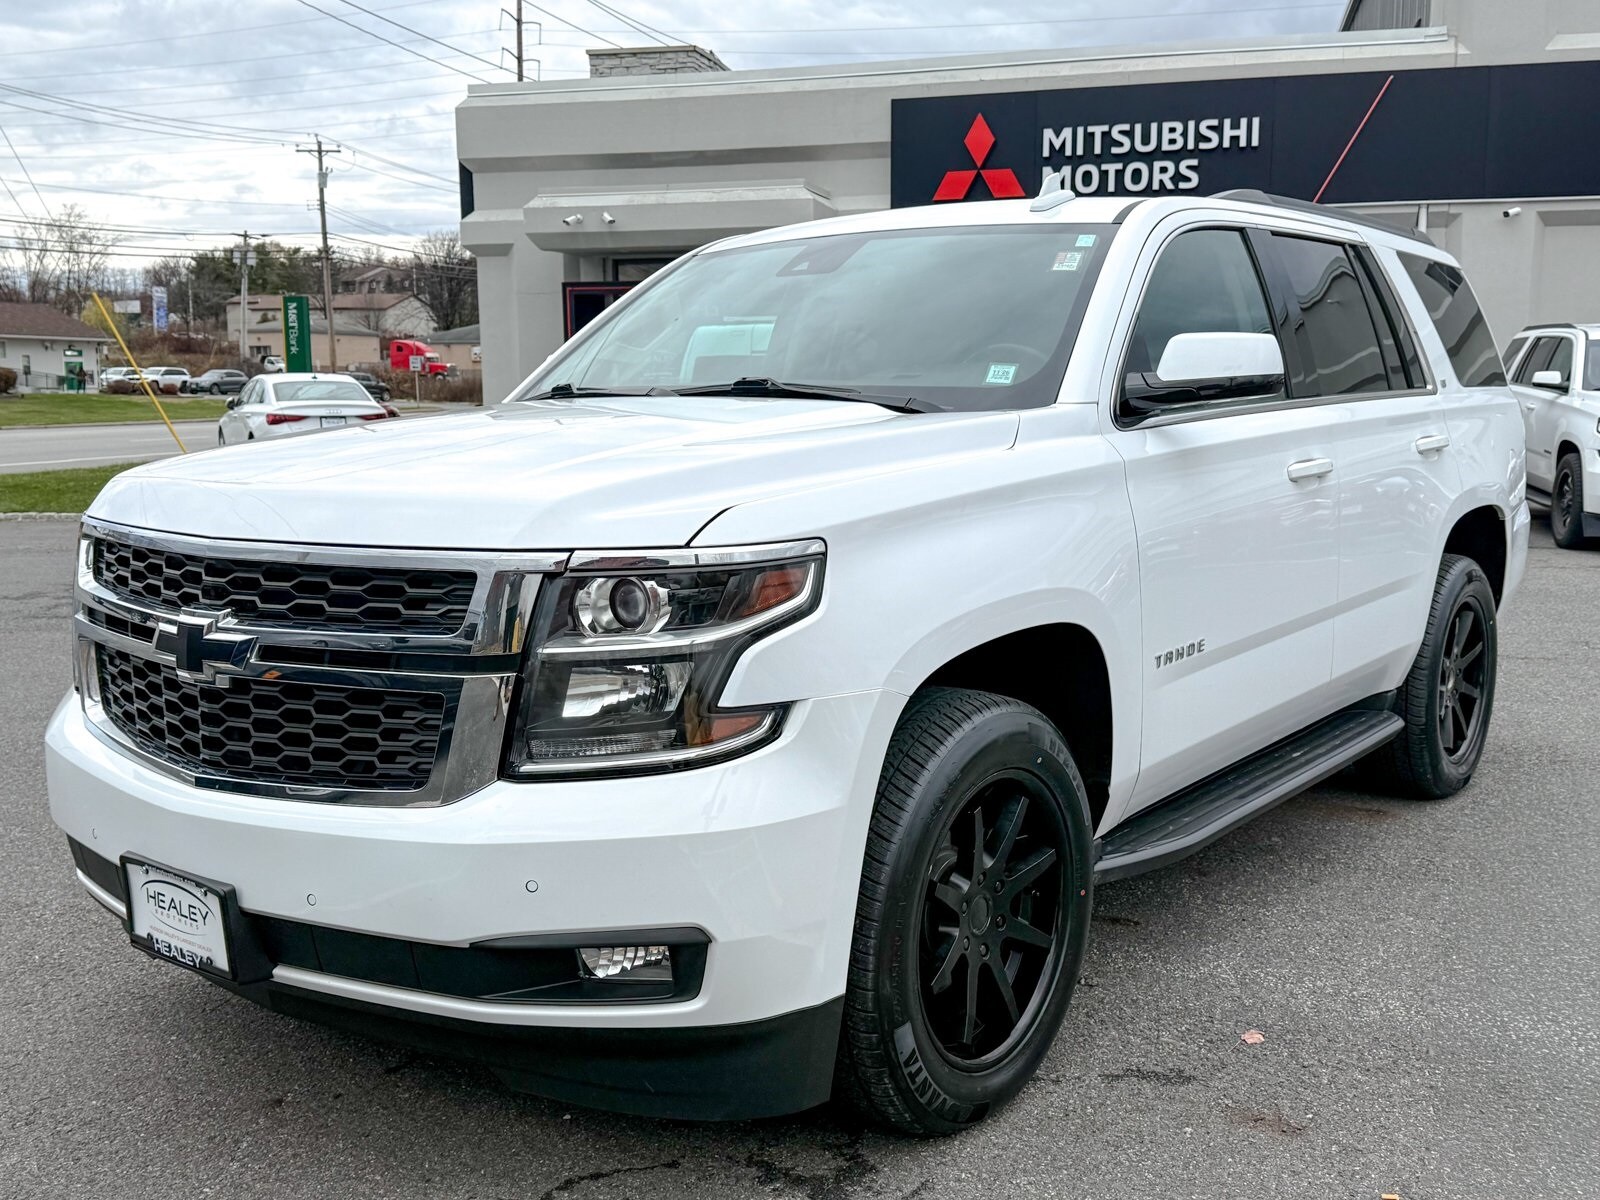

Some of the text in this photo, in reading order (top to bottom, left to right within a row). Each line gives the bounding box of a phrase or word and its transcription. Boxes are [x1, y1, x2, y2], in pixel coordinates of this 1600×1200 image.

[1042, 115, 1261, 158] MITSUBISHI
[1041, 158, 1200, 194] MOTORS
[289, 328, 300, 355] Bank
[1154, 638, 1206, 669] TAHOE
[145, 887, 209, 926] HEALEY
[153, 938, 203, 969] HEALEY
